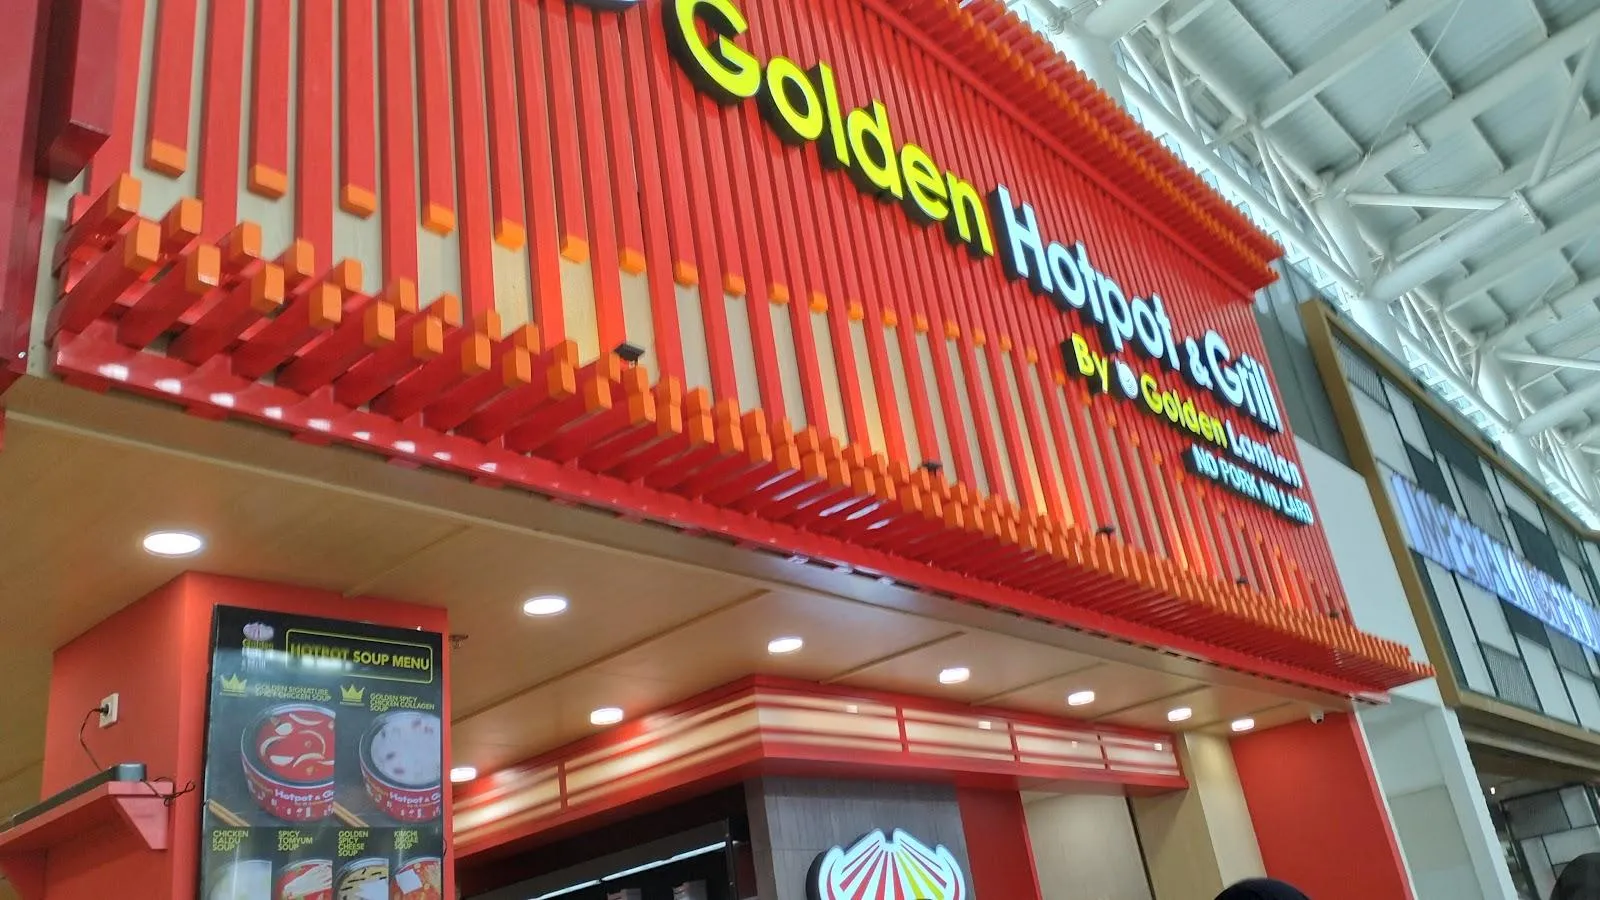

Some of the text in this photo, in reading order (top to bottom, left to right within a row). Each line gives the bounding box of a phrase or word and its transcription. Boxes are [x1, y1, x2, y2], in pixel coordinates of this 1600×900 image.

[675, 0, 995, 257] Golden
[998, 183, 1284, 434] Hotpot & Grill
[1072, 332, 1303, 489] By Golden Lamian
[1192, 443, 1314, 526] NO PORK NO LARD
[353, 650, 389, 666] SOUP
[392, 655, 430, 670] MENU
[288, 686, 329, 695] SIGNATURE
[278, 691, 311, 700] CHICKEN
[312, 694, 332, 702] SOUP
[370, 693, 398, 702] GOLDEN
[370, 704, 388, 712] SOUP
[400, 701, 435, 710] COLLAGEN
[275, 789, 313, 803] Hotpot
[389, 791, 423, 804] Hotpot
[213, 830, 249, 838] CHICKEN
[279, 830, 300, 838] SPICY
[338, 830, 369, 838] GOLDEN
[279, 837, 313, 845] TOMYUM
[213, 843, 235, 851] SOUP
[278, 843, 299, 851] SOUP
[394, 842, 413, 850] SOUP
[338, 849, 358, 857] SOUP
